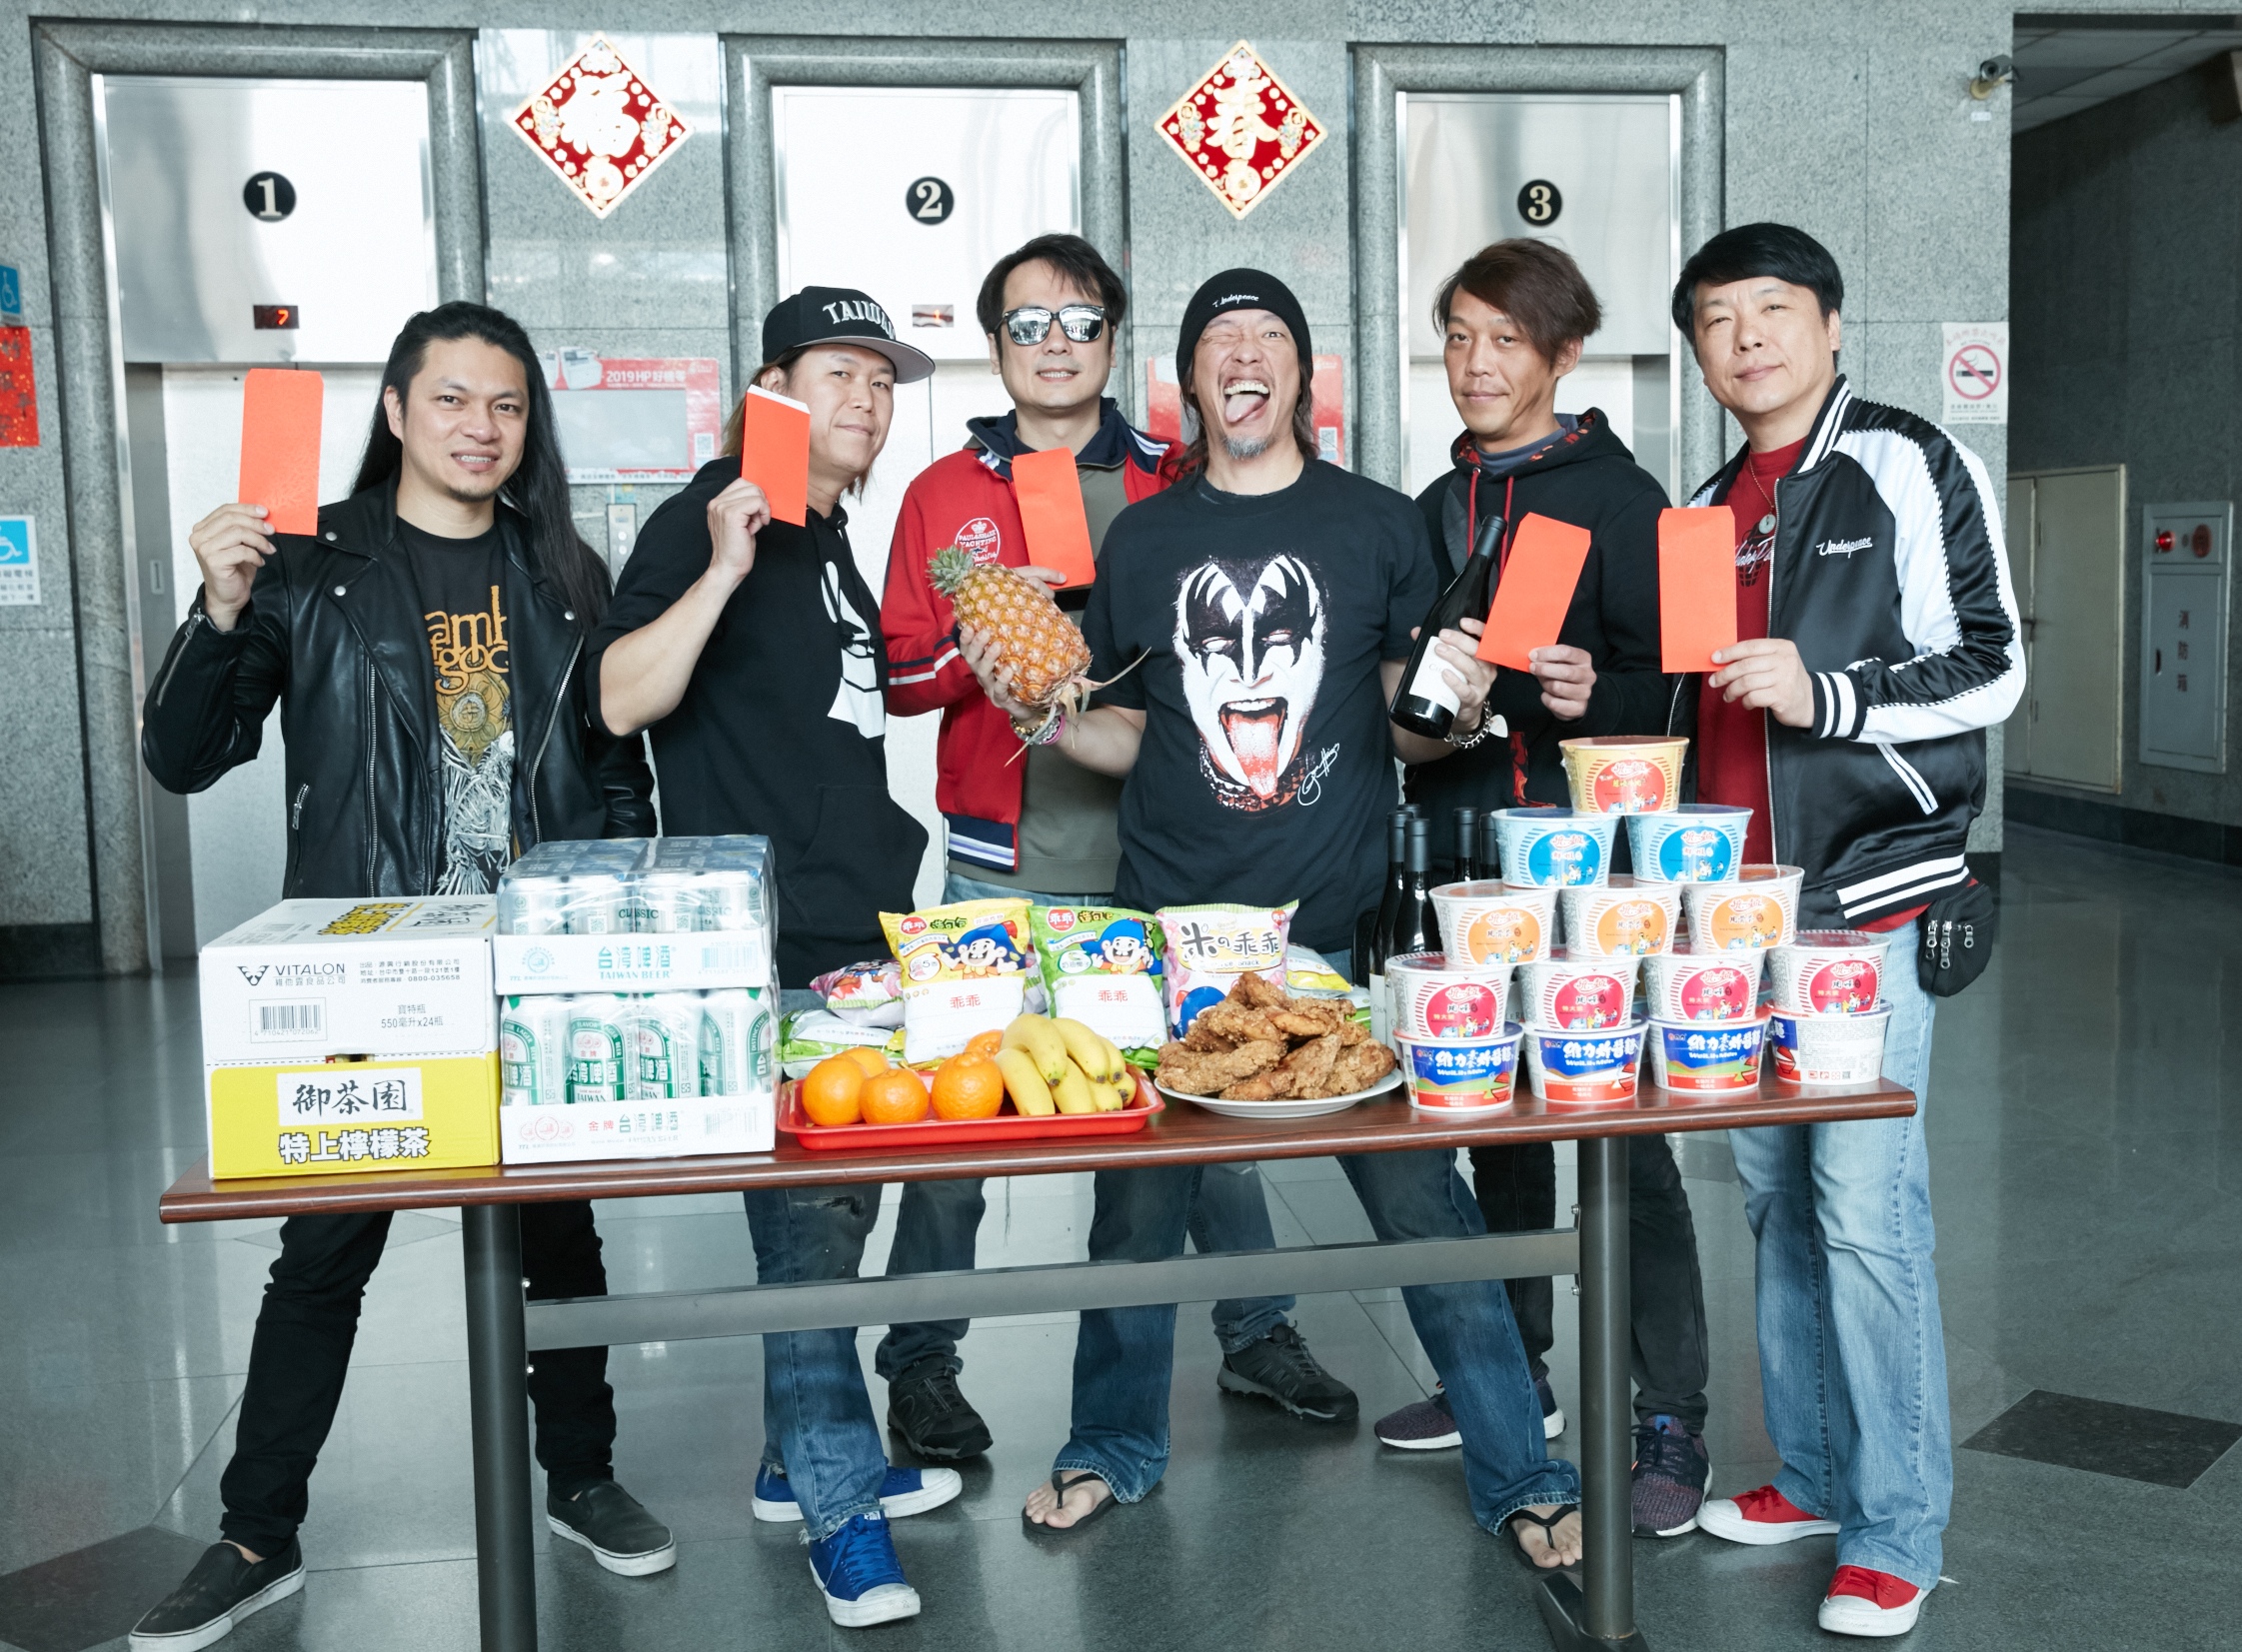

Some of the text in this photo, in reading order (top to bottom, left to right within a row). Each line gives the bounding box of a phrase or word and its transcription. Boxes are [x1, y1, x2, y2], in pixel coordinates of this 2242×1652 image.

[1205, 76, 1281, 161] 春
[257, 177, 283, 217] 1
[915, 180, 944, 219] 2
[1526, 184, 1553, 223] 3
[277, 309, 289, 325] 7
[618, 907, 659, 919] CLASSIC
[1049, 911, 1074, 925] 乖乖
[902, 920, 926, 931] 乖乖
[1180, 921, 1280, 959] 米の乖乖
[275, 962, 346, 976] VITALON
[600, 970, 671, 980] TAIWAN BEER
[950, 993, 982, 1009] 乖乖
[1098, 989, 1128, 1003] 乖乖
[398, 1003, 426, 1014] 寶特瓶
[292, 1079, 408, 1117] 御茶園
[588, 1120, 615, 1131] 金牌
[278, 1126, 432, 1165] 特上檸檬茶
